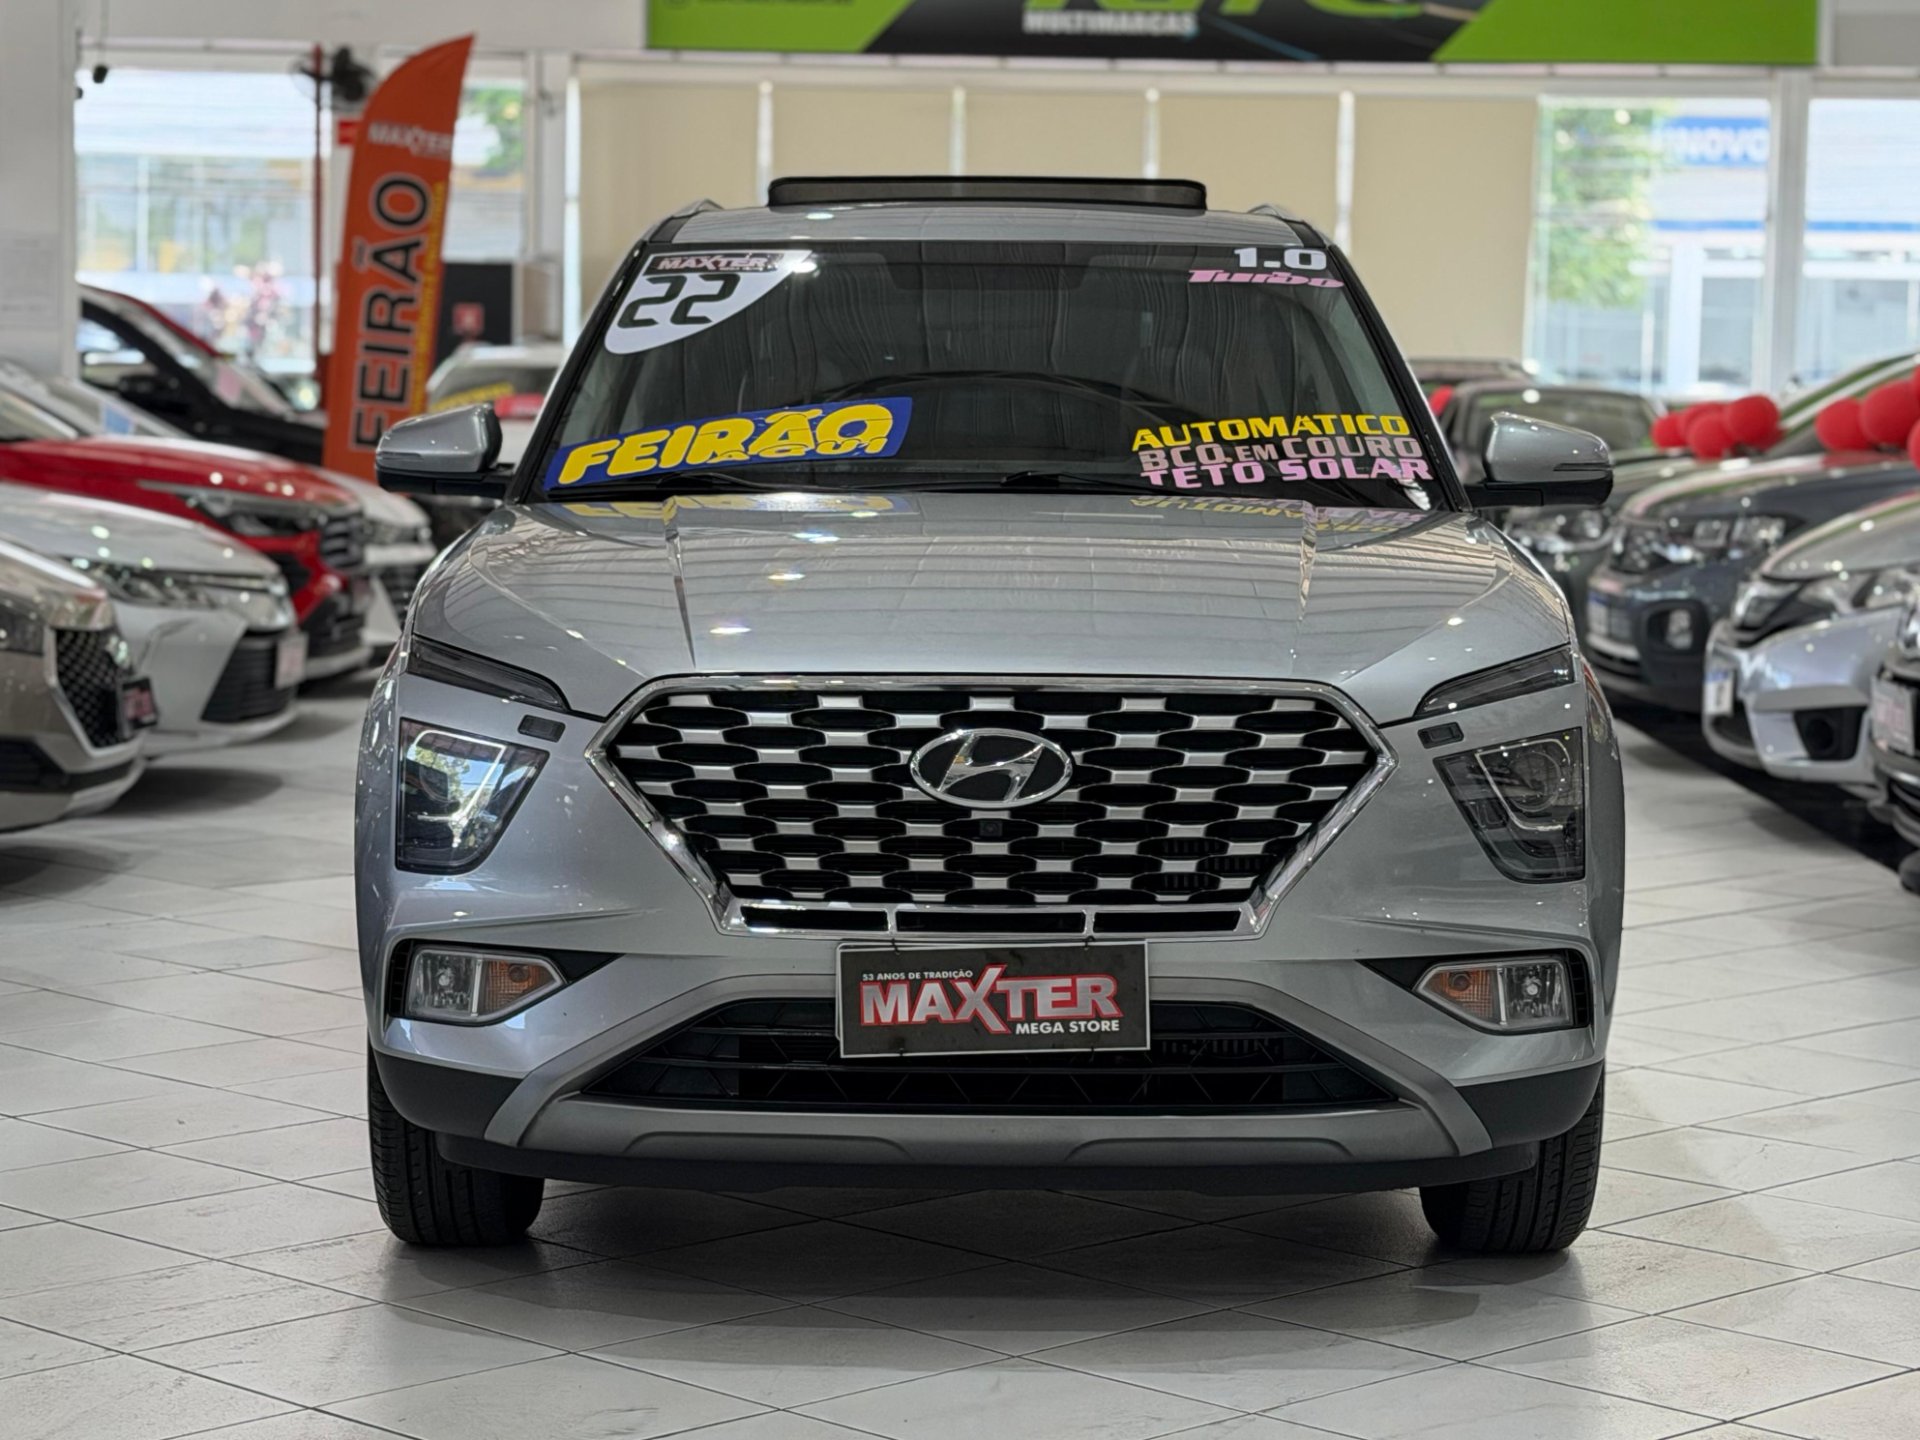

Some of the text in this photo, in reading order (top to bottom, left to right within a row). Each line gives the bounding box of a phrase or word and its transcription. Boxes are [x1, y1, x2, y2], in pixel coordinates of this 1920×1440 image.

[657, 255, 769, 271] MAXTER
[1234, 247, 1327, 270] 1.0
[1188, 269, 1345, 288] Turbo
[351, 170, 432, 450] FEIRÃO
[617, 273, 741, 329] 22
[558, 404, 893, 484] FEIRÃO
[1238, 443, 1278, 461] EM
[1282, 436, 1422, 458] COURO
[1140, 458, 1433, 489] TETO SOLAR
[877, 972, 906, 980] ANOS
[908, 972, 921, 980] DE
[923, 969, 973, 981] TRADIÇÃO
[860, 964, 1124, 1034] MAXTER
[1015, 1020, 1120, 1035] MEGA STORE
